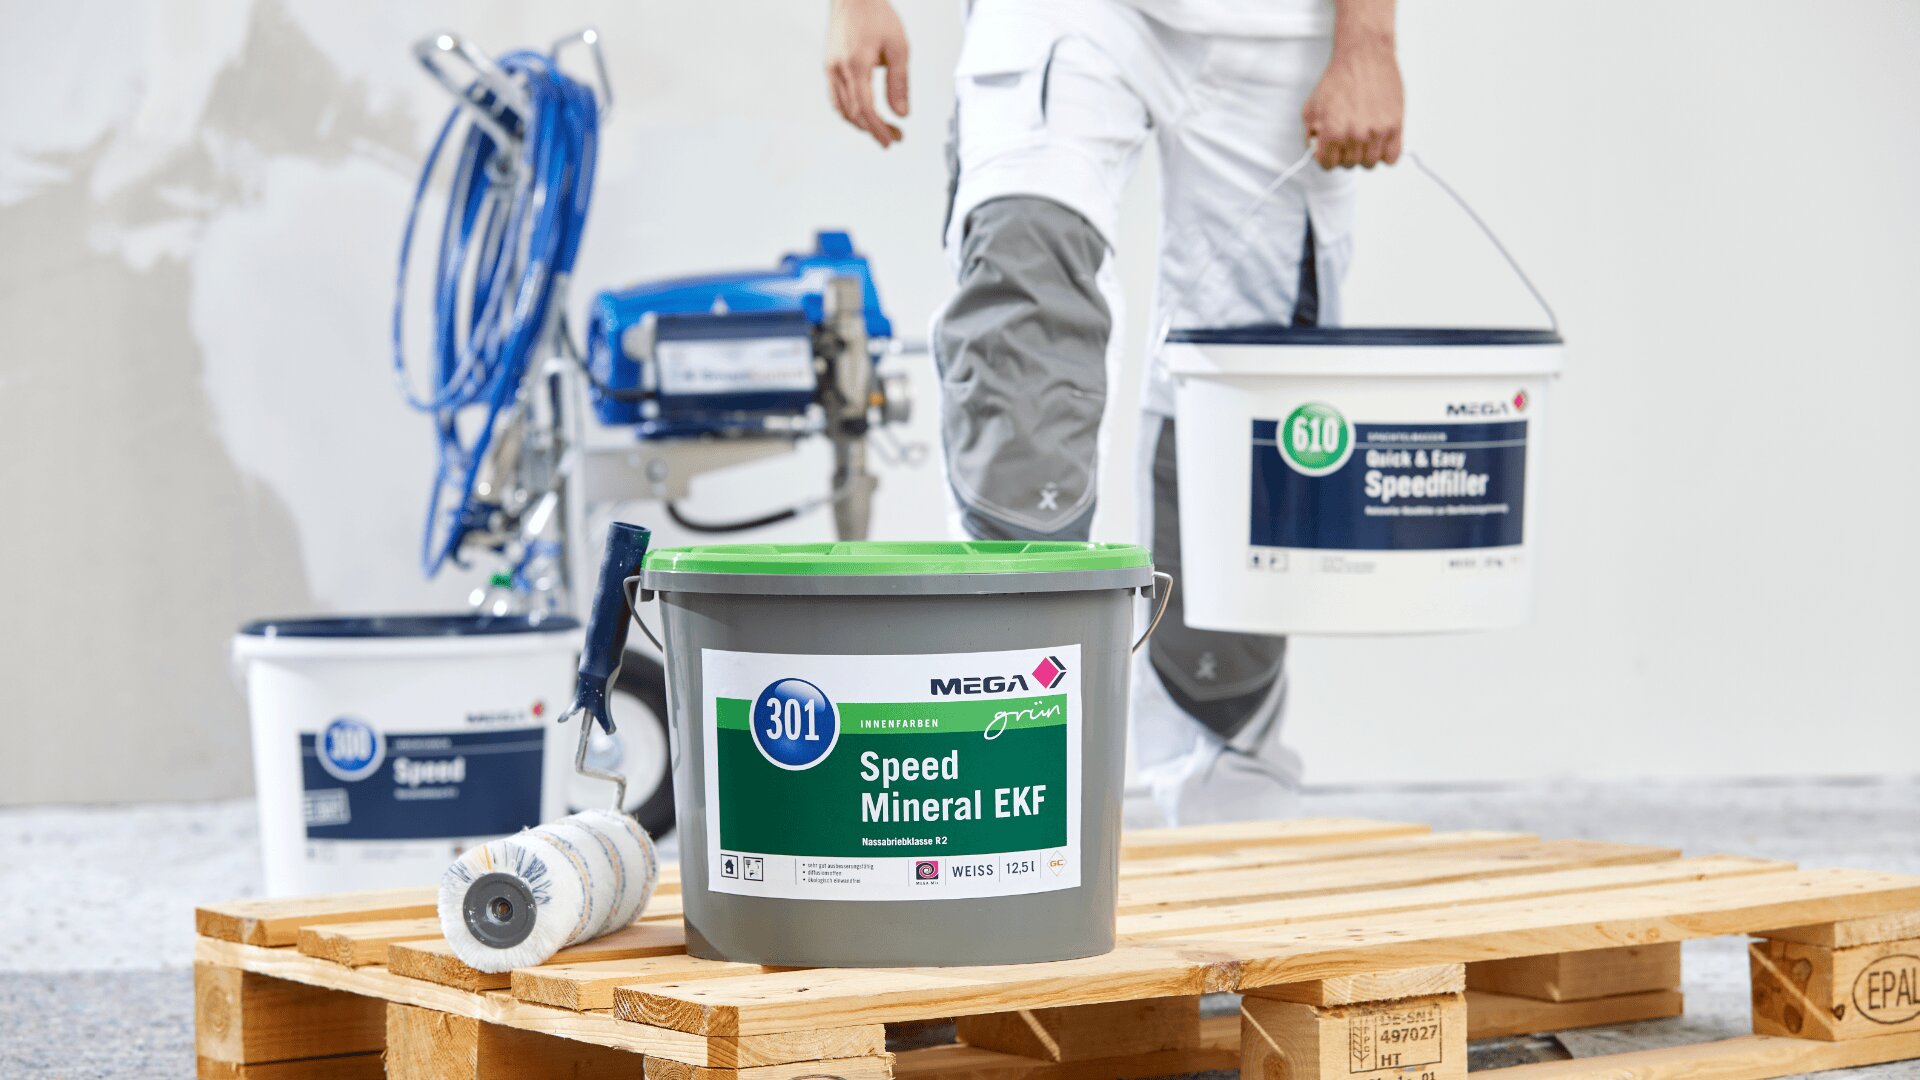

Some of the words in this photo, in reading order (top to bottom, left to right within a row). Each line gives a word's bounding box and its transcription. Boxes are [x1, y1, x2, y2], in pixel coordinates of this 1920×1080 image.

[1447, 403, 1508, 417] MEGA
[1292, 416, 1339, 453] 610
[1366, 449, 1412, 469] Quick
[1414, 449, 1428, 469] &
[1431, 449, 1466, 469] Easy
[1364, 471, 1488, 503] Speedfiller
[931, 677, 1028, 695] MEGA
[766, 698, 820, 741] 301
[860, 719, 939, 728] INNENFARBEN
[983, 700, 1060, 740] grün
[393, 756, 466, 788] Speed
[860, 750, 958, 788] Speed
[861, 790, 982, 822] Mineral
[994, 785, 1046, 818] EKF
[862, 837, 933, 846] Nassabriebklasse
[952, 865, 994, 877] WEISS
[1006, 862, 1029, 875] 12,5
[1868, 970, 1920, 1010] EPAL
[1380, 1025, 1437, 1043] 497027
[1381, 1053, 1401, 1066] HT
